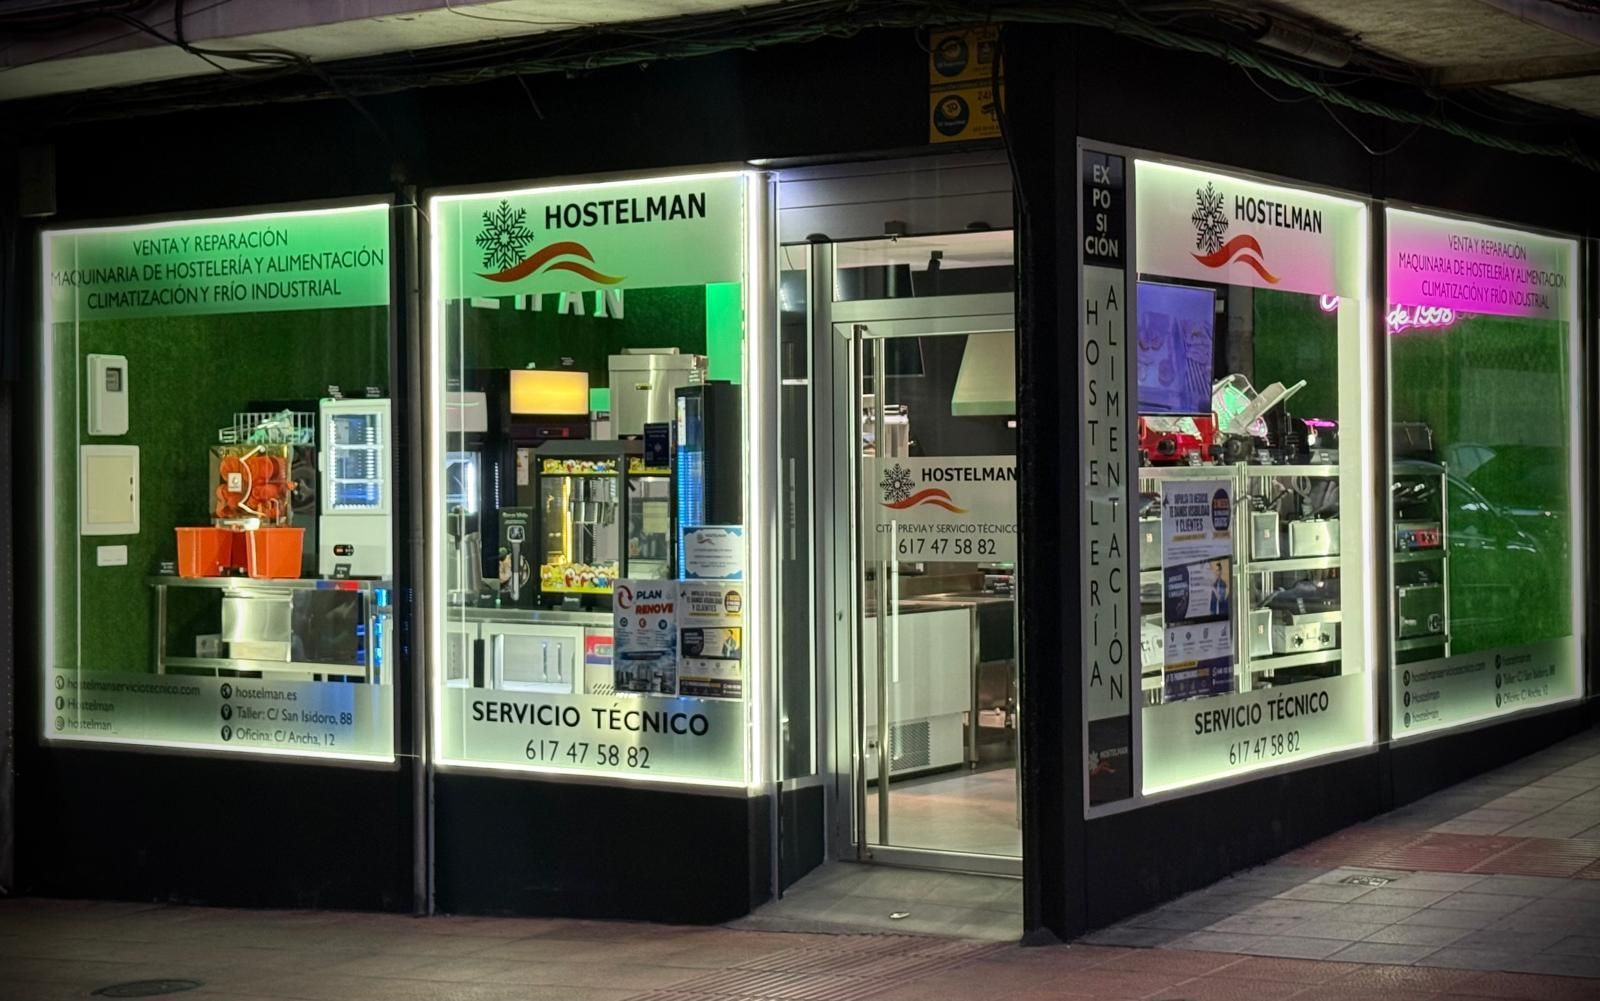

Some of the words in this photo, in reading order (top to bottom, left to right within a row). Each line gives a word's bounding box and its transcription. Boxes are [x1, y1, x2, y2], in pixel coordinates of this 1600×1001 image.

[1093, 165, 1110, 185] EX
[545, 192, 706, 229] HOSTELMAN
[1093, 188, 1111, 209] PO
[1096, 213, 1107, 232] SI
[1235, 194, 1322, 233] HOSTELMAN
[133, 236, 178, 256] VENTA
[181, 237, 191, 253] Y
[195, 226, 288, 252] REPARACIÓN
[1085, 230, 1119, 258] CIÓN
[1448, 234, 1473, 253] VENTA
[1472, 240, 1479, 252] Y
[1481, 240, 1527, 260] REPARACIÓN
[51, 263, 139, 287] MAQUINARIA
[144, 264, 162, 282] DE
[166, 254, 252, 280] HOSTELERÍA
[253, 257, 264, 274] Y
[267, 245, 384, 273] ALIMENTACIÓN
[1399, 253, 1451, 274] MAQUINARIA
[1454, 260, 1464, 276] DE
[1466, 261, 1510, 282] HOSTELERÍA
[1509, 269, 1515, 281] Y
[88, 283, 197, 310] CLIMATIZACIÓN
[198, 286, 210, 303] Y
[214, 281, 247, 301] FRÍO
[252, 279, 341, 299] INDUSTRIAL
[1422, 280, 1484, 301] CLIMATIZACIÓN
[1483, 287, 1490, 300] Y
[1509, 292, 1550, 309] INDUSTRIAL
[922, 467, 1017, 482] HOSTELMAN
[1086, 299, 1102, 687] HOSTELERÍA
[1106, 285, 1123, 700] ALIMENTACIÓN
[875, 524, 892, 533] CIT
[898, 524, 927, 533] PREVIA
[927, 524, 934, 533] Y
[936, 523, 976, 533] SERVICIO
[899, 538, 925, 554] 617
[930, 538, 949, 554] 47
[954, 538, 973, 555] 58
[977, 538, 997, 555] 82
[635, 603, 674, 615] RENOVE
[636, 590, 662, 600] PLAN
[68, 698, 114, 712] Hstelman
[235, 686, 297, 701] hostelman.es
[236, 705, 265, 720] Taller:
[266, 707, 279, 721] C/
[282, 708, 299, 721] San
[302, 710, 338, 725] Isidoro,
[340, 712, 353, 725] 88
[473, 700, 580, 728] SERVICIO
[592, 703, 709, 737] TÉCNICO
[1195, 702, 1262, 735] SERVICIO
[1267, 690, 1329, 722] TÉCNICO
[274, 729, 286, 743] C/
[288, 731, 320, 746] Ancha,
[324, 733, 335, 746] 12
[1229, 740, 1249, 766] 617
[1254, 736, 1267, 759] 47
[1271, 733, 1284, 757] 58
[1287, 729, 1301, 753] 82
[525, 739, 559, 762] 617
[567, 742, 589, 764] 47
[597, 745, 620, 767] 58
[627, 746, 651, 769] 82
